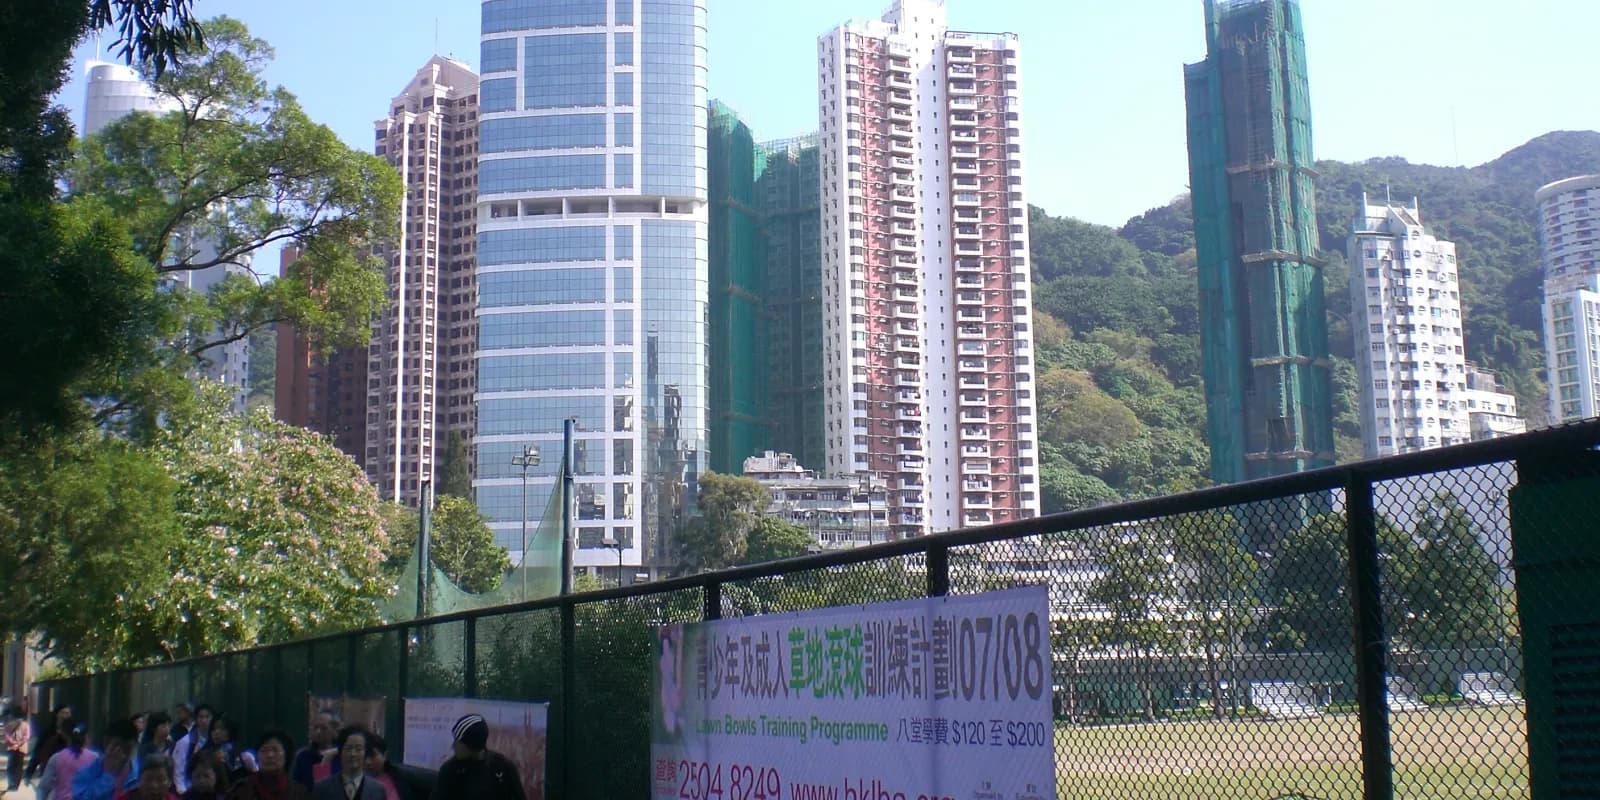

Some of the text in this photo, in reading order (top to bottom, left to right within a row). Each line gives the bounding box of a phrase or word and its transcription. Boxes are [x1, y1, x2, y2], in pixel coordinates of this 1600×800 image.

[696, 713, 889, 745] Lawn Bowls Training Programme
[896, 717, 1046, 748] 八堂學費 $120 至 $200
[679, 759, 724, 800] 2504
[730, 764, 781, 800] 8249
